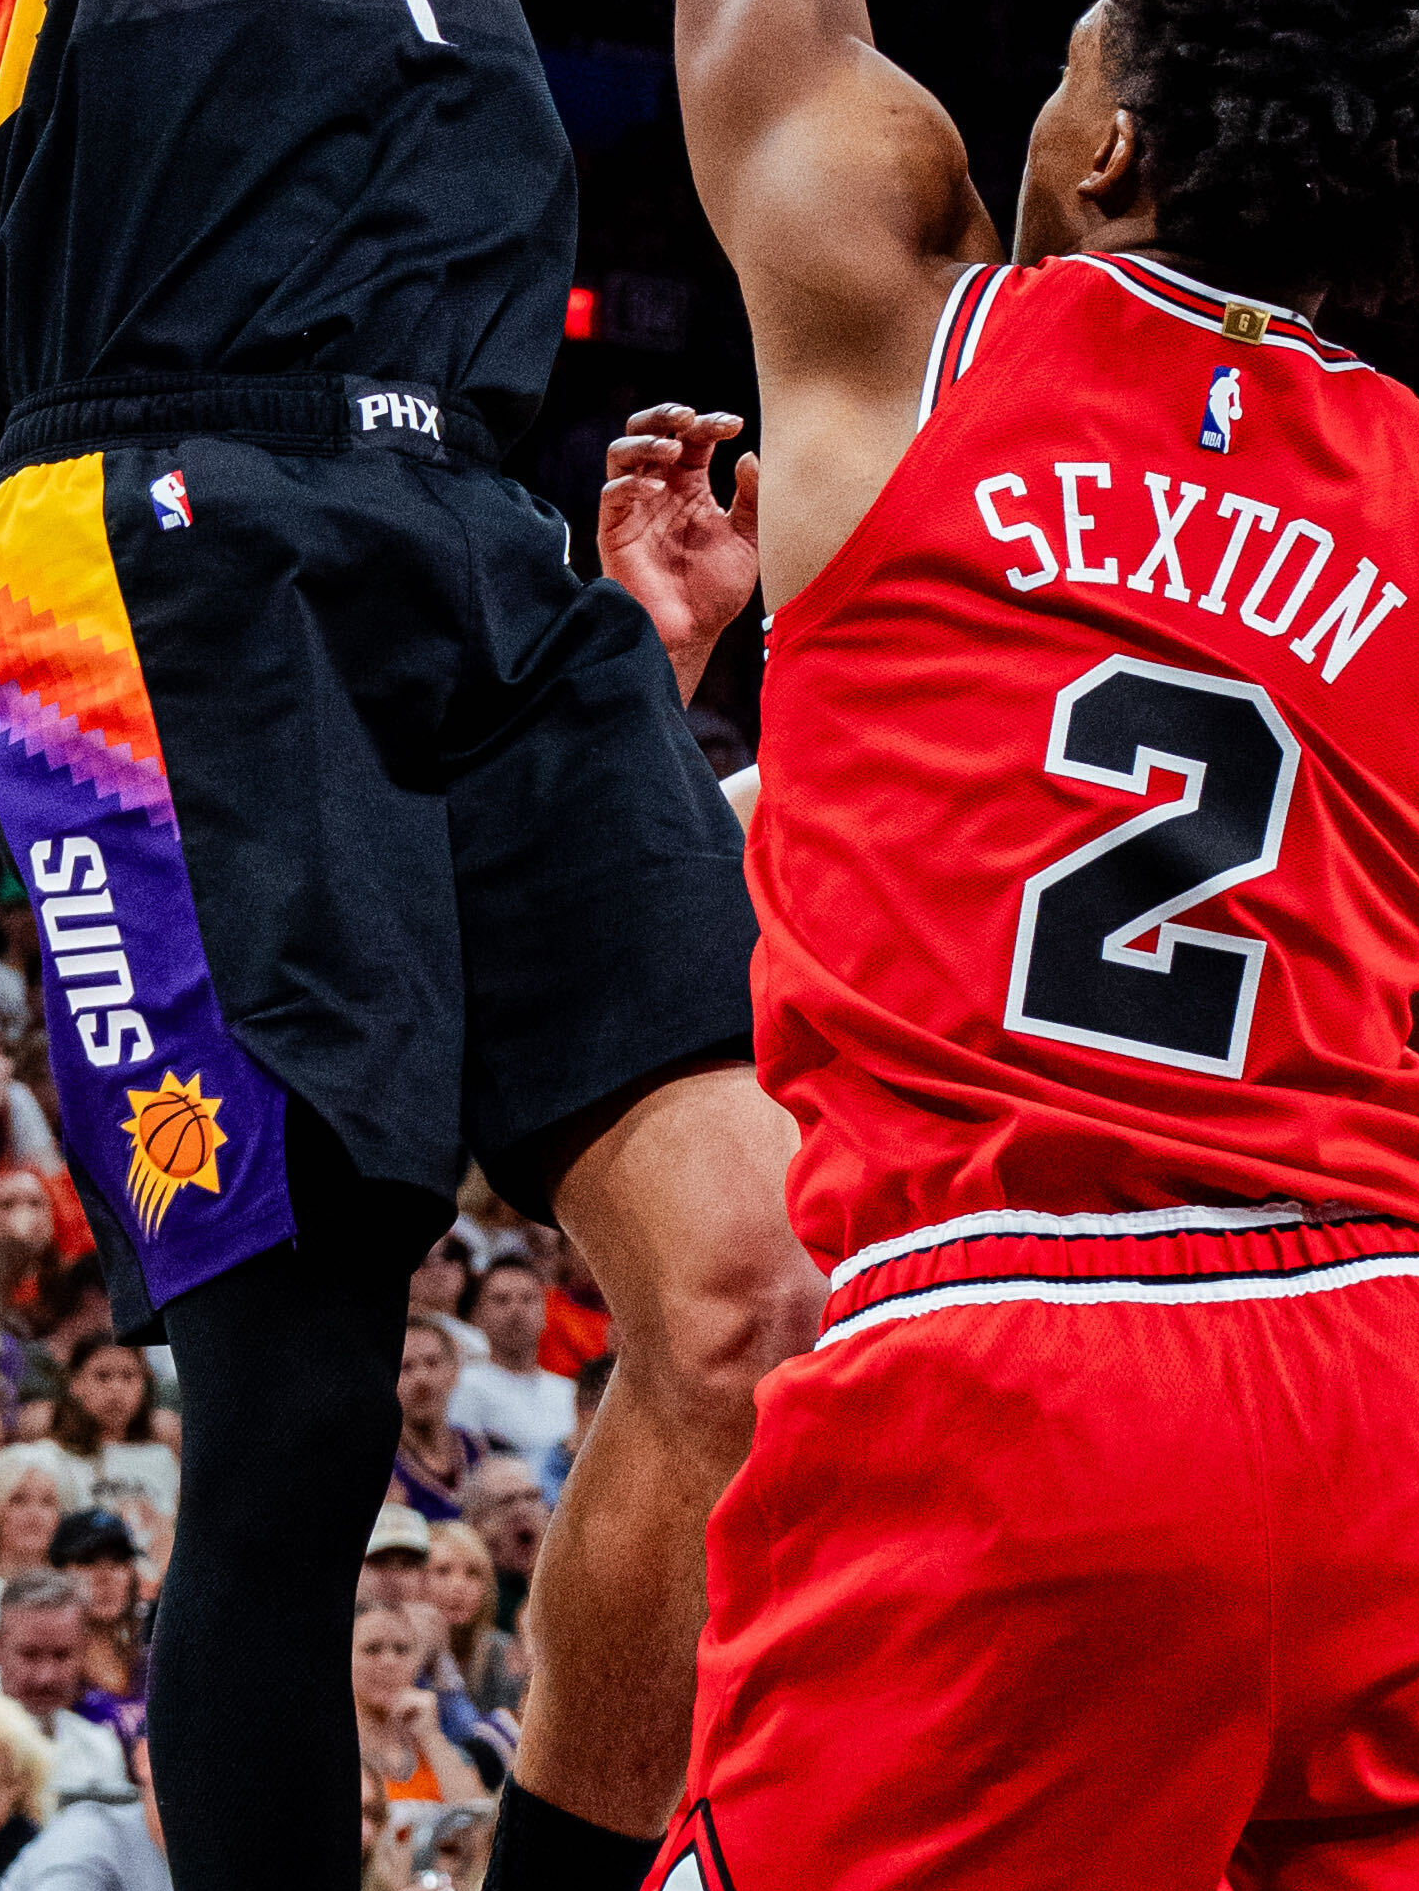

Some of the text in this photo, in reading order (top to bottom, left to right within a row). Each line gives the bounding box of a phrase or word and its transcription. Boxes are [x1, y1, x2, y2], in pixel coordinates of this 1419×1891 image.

[357, 392, 441, 441] PHX
[1201, 430, 1223, 449] NBA
[974, 462, 1408, 685] SEXTON
[29, 835, 155, 1068] SUNS
[1003, 653, 1302, 1080] 2
